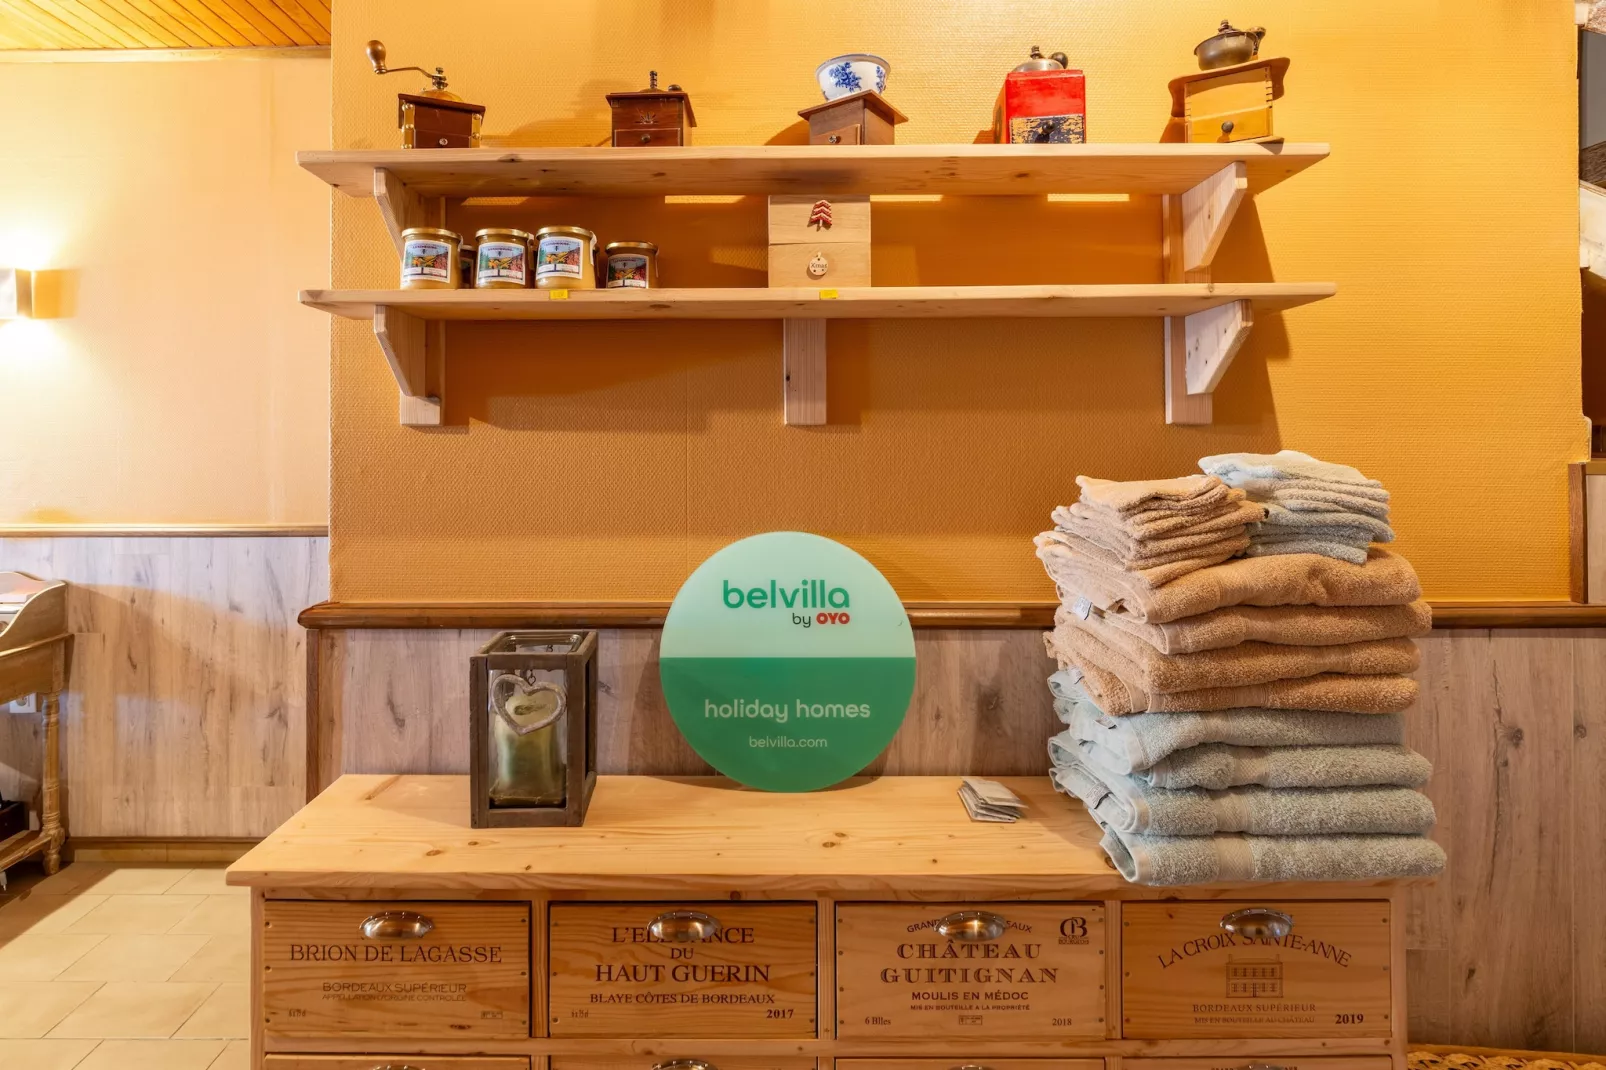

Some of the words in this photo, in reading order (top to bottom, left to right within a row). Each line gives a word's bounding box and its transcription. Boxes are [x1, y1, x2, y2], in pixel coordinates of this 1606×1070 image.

[723, 580, 850, 609] belvilla
[792, 613, 811, 628] by
[816, 612, 850, 625] OYO
[704, 699, 788, 723] holiday
[796, 699, 871, 718] homes
[749, 736, 828, 748] belvilla.com
[897, 939, 1041, 959] CHÂTEAU
[1183, 932, 1236, 957] CROIX
[290, 944, 358, 962] BRION
[364, 946, 393, 963] DE
[400, 946, 502, 963] LAGASSE
[671, 948, 694, 959] DU
[595, 965, 665, 982] HAUT
[672, 965, 771, 982] GUERIN
[880, 967, 1058, 984] GUITIGNAN
[322, 982, 392, 993] BORDEAUX
[394, 981, 467, 994] SUPÉRIEUR
[590, 994, 633, 1004] BLAYE
[635, 991, 678, 1004] CÔTES
[681, 994, 699, 1004] DE
[702, 994, 775, 1004] BORDEAUX
[911, 992, 959, 1001] MOULIS
[964, 992, 980, 1001] EN
[984, 989, 1029, 1001] MÉDOC
[767, 1009, 794, 1019] 2017
[1193, 1004, 1253, 1013] BORDEAUX
[1256, 1002, 1316, 1013] SUPÉRIEUR
[865, 1016, 870, 1025] 6
[1052, 1017, 1072, 1026] 2018
[1335, 1014, 1364, 1024] 2019
